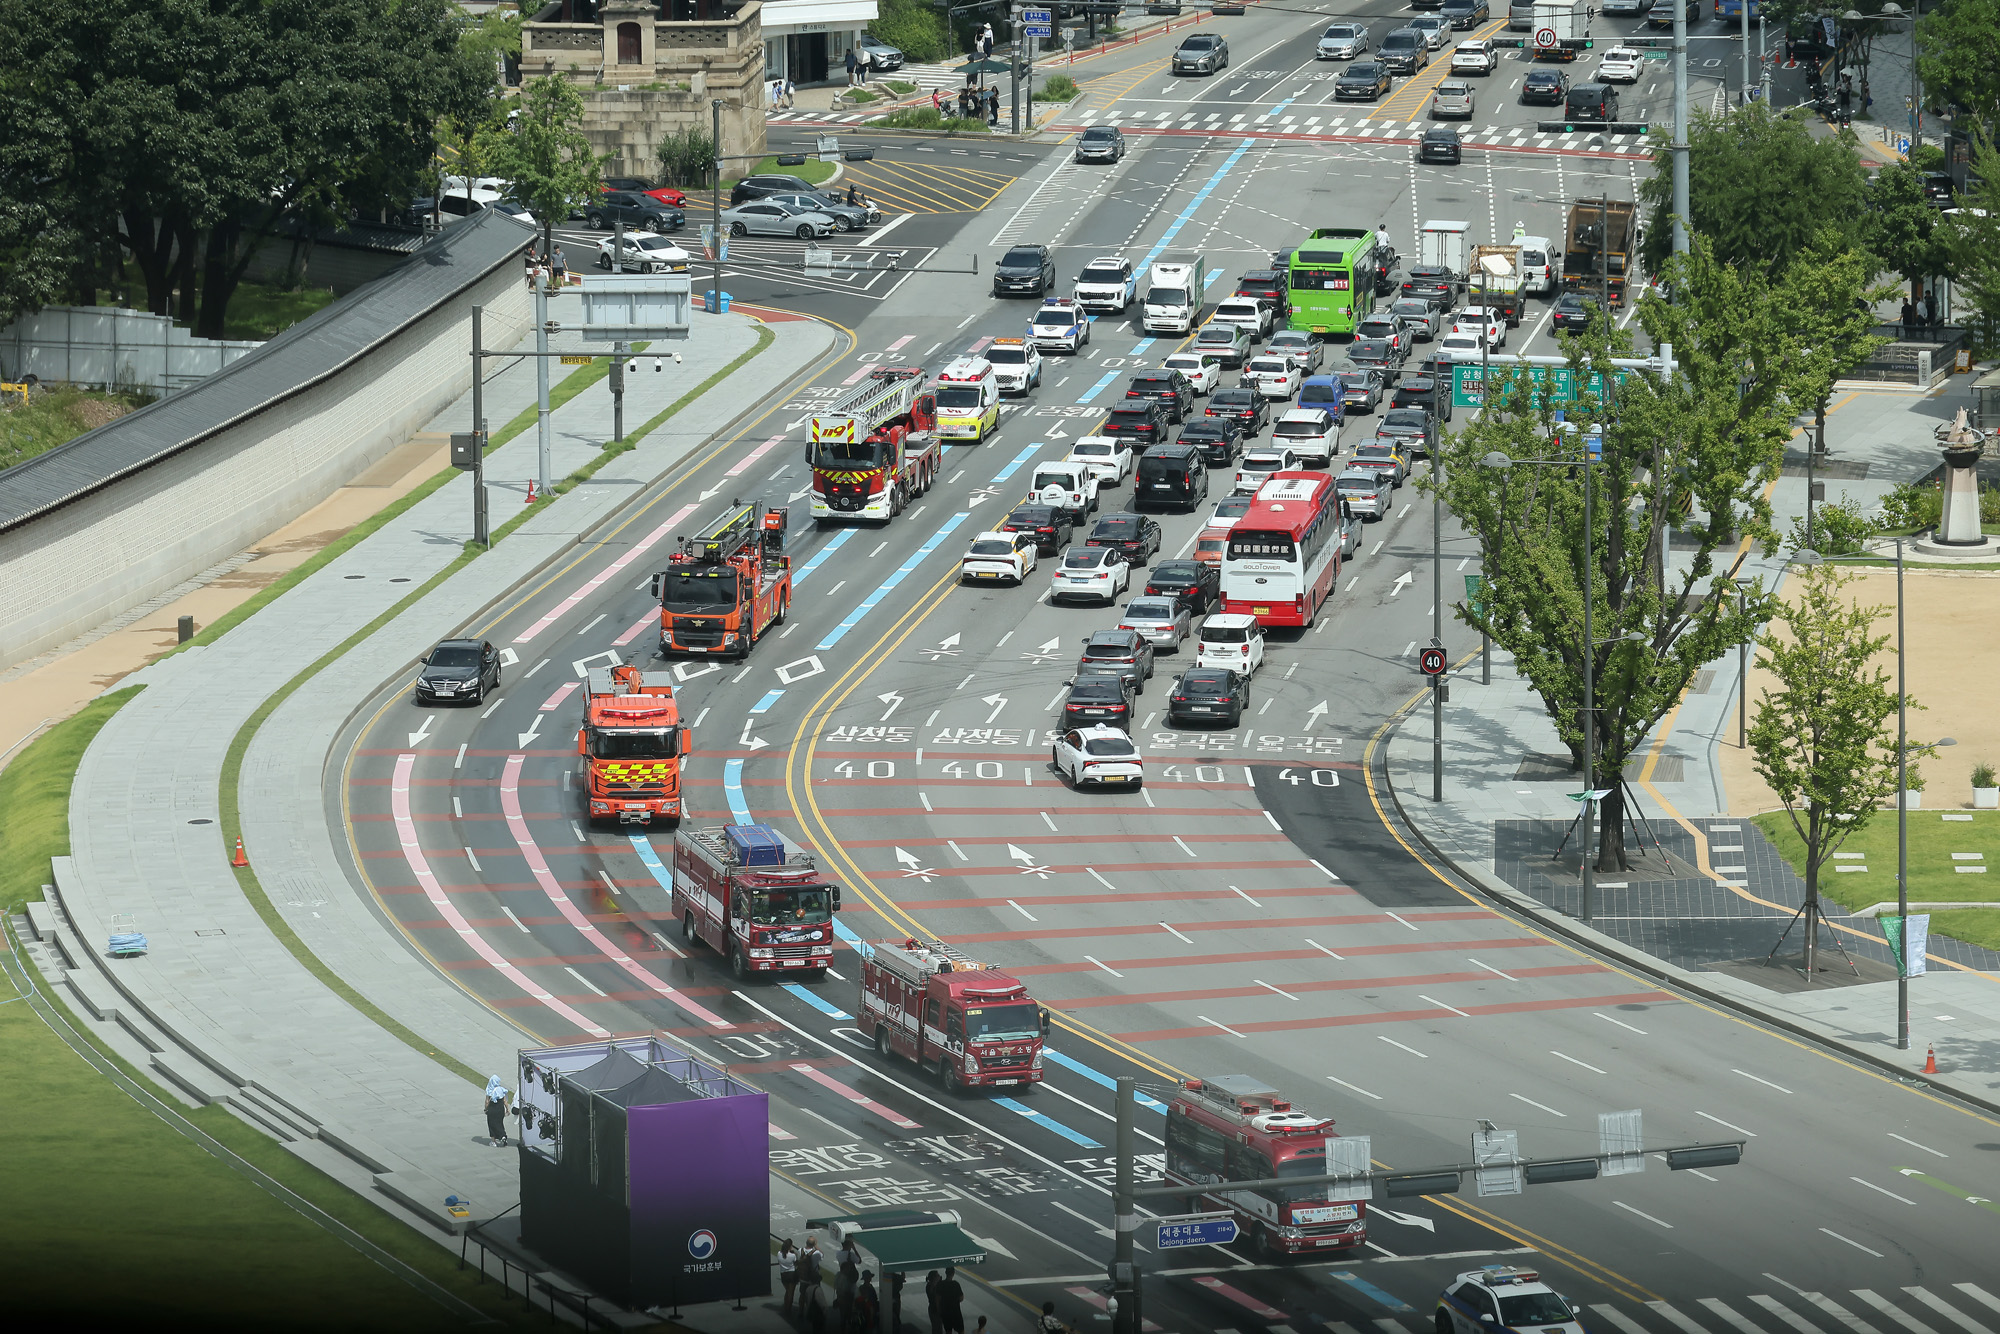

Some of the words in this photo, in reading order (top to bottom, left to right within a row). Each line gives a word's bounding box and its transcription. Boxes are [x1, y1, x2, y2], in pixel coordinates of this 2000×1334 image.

[1540, 32, 1552, 40] 40
[1100, 358, 1149, 368] 40
[821, 425, 846, 438] 119
[1427, 656, 1440, 668] 40
[825, 725, 915, 743] 삼청동
[931, 727, 1022, 745] 삼청동
[1150, 732, 1237, 750] 율곡로
[1257, 735, 1343, 755] 율곡로
[834, 760, 895, 778] 40
[941, 761, 1003, 779] 40
[1163, 765, 1225, 782] 40
[1279, 768, 1340, 787] 40
[888, 1004, 901, 1018] 119
[981, 1048, 996, 1056] 서울
[1161, 1225, 1201, 1238] 세종대로
[1161, 1237, 1206, 1246] Sejong-daero
[683, 1261, 722, 1273] 국가보훈부
